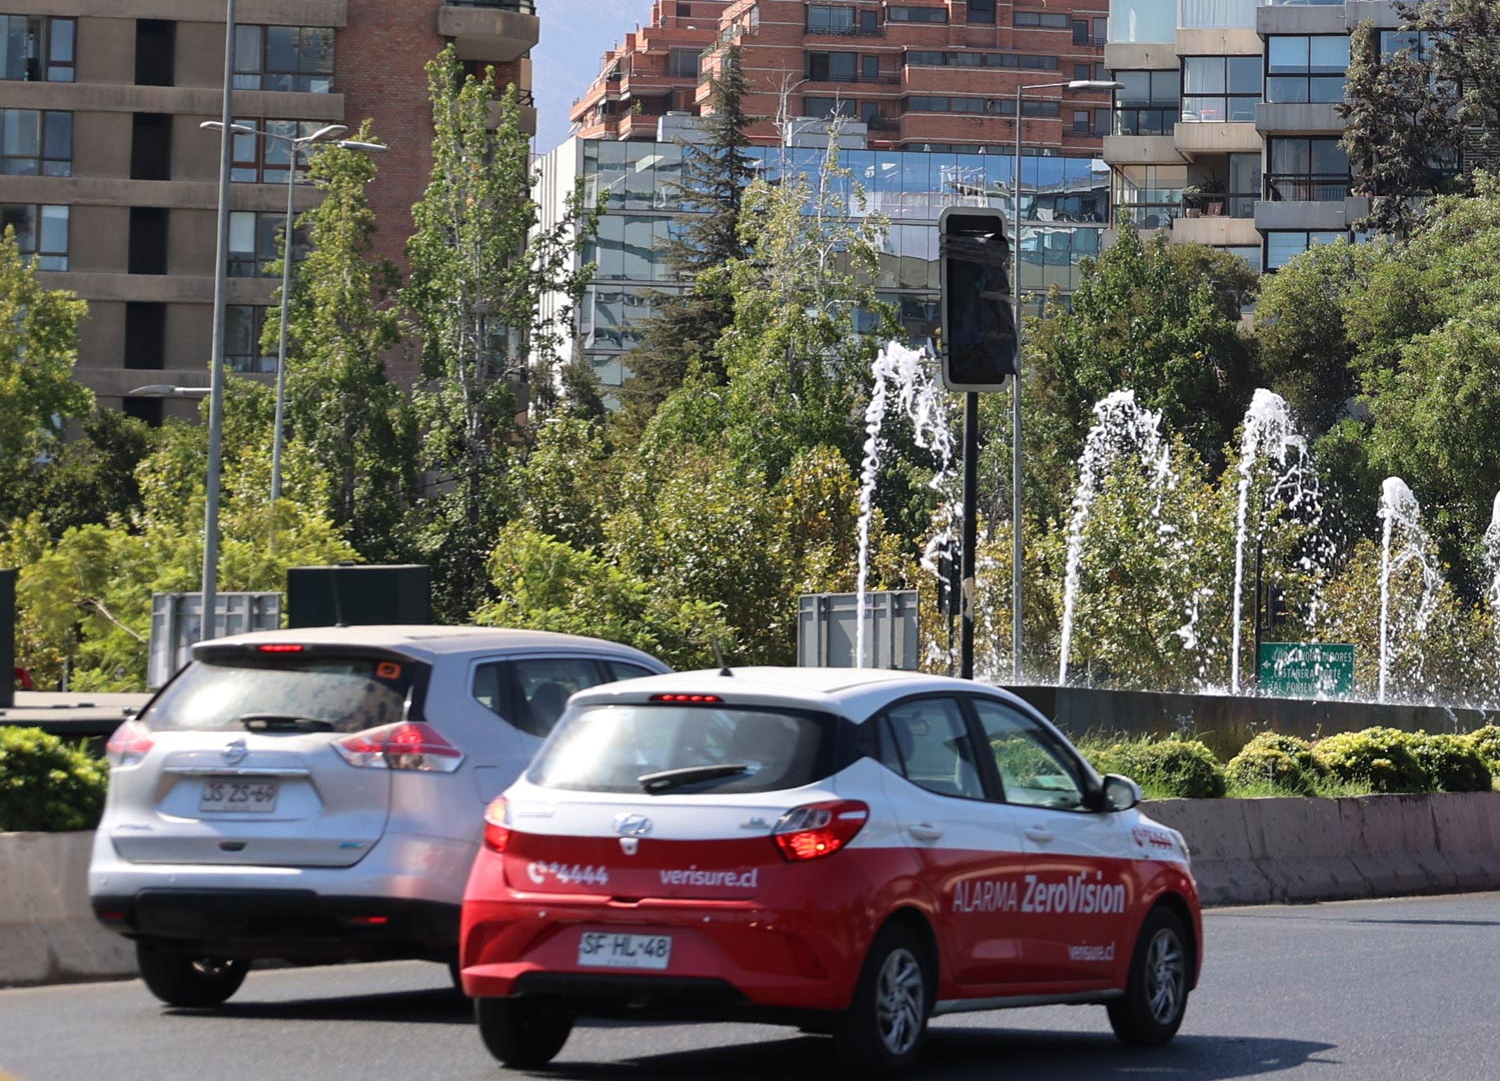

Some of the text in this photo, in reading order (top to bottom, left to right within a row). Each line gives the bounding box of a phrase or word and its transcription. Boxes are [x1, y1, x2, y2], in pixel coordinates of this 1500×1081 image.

[660, 865, 758, 887] verisure.cl
[952, 871, 1126, 914] ALARMA ZeroVision
